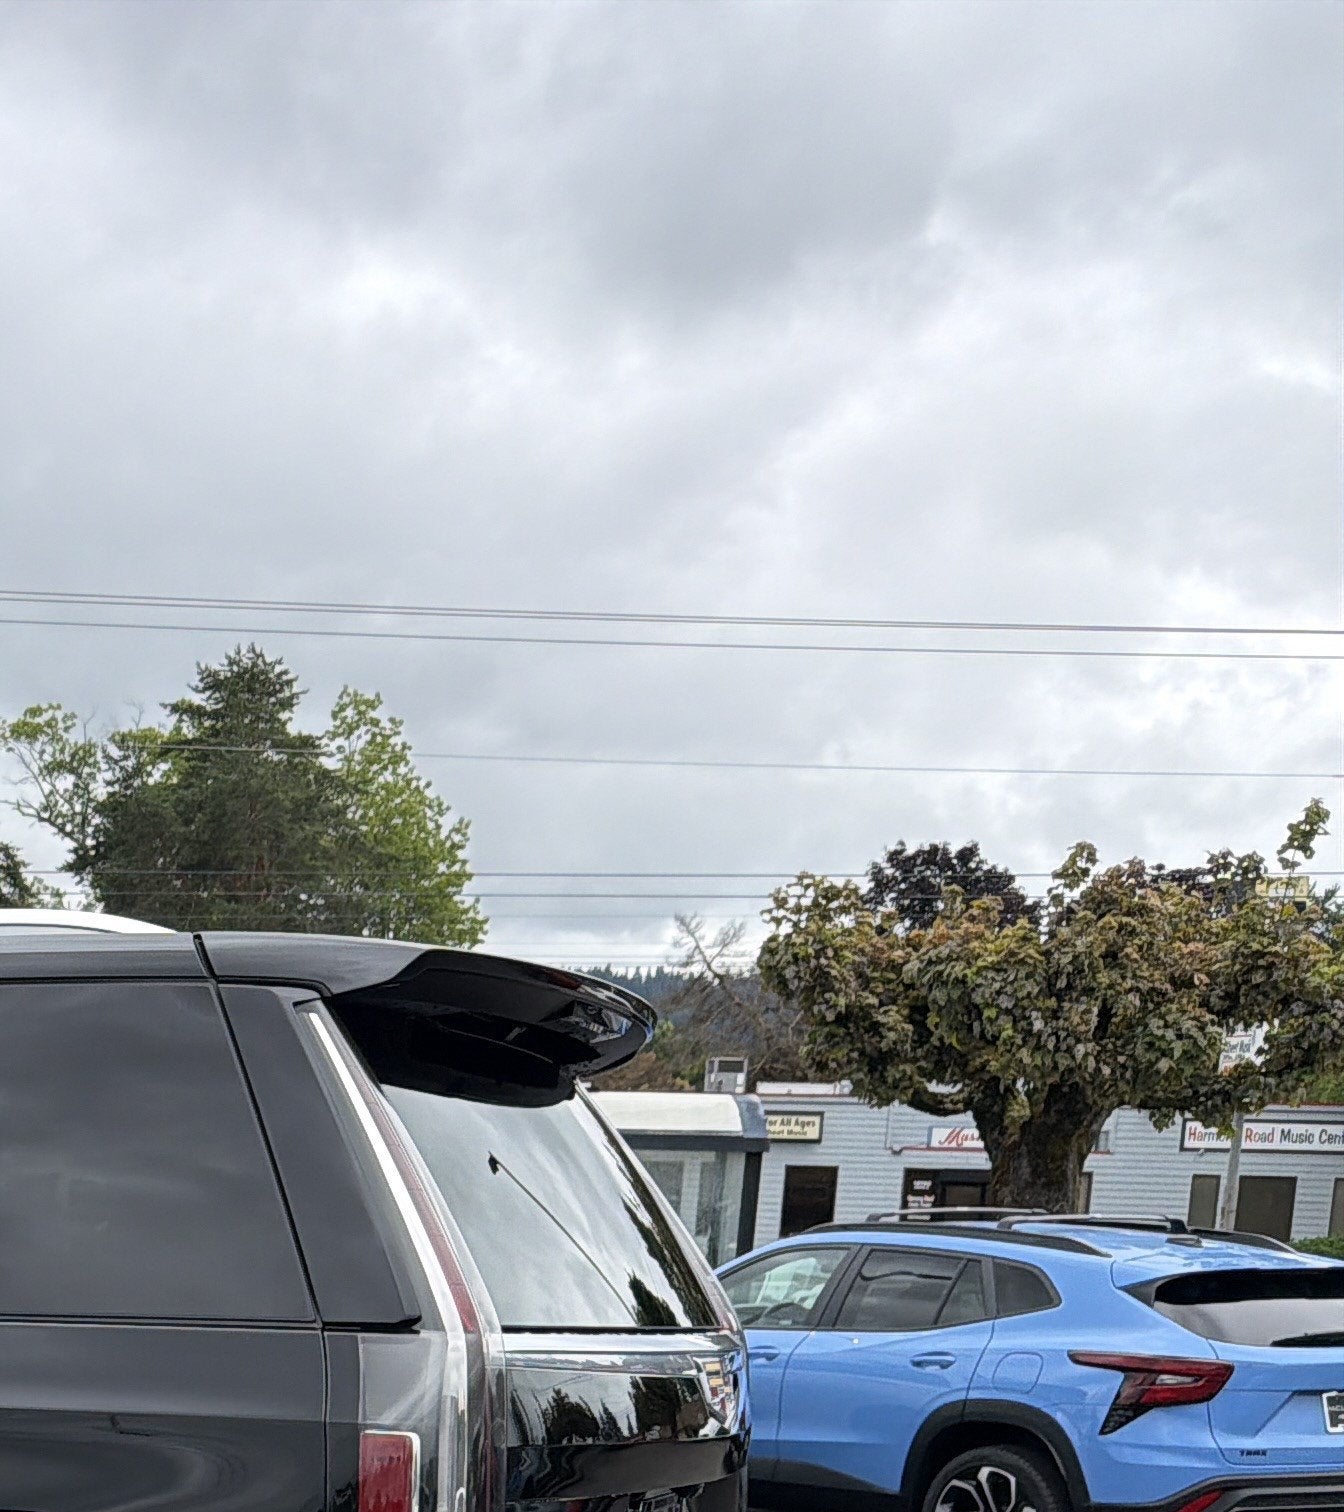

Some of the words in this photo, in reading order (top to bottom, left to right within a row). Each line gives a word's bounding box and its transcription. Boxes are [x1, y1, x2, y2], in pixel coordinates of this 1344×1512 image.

[779, 1117, 792, 1127] All
[794, 1117, 816, 1130] Ages
[1245, 1128, 1276, 1143] Road
[1279, 1128, 1315, 1144] Music
